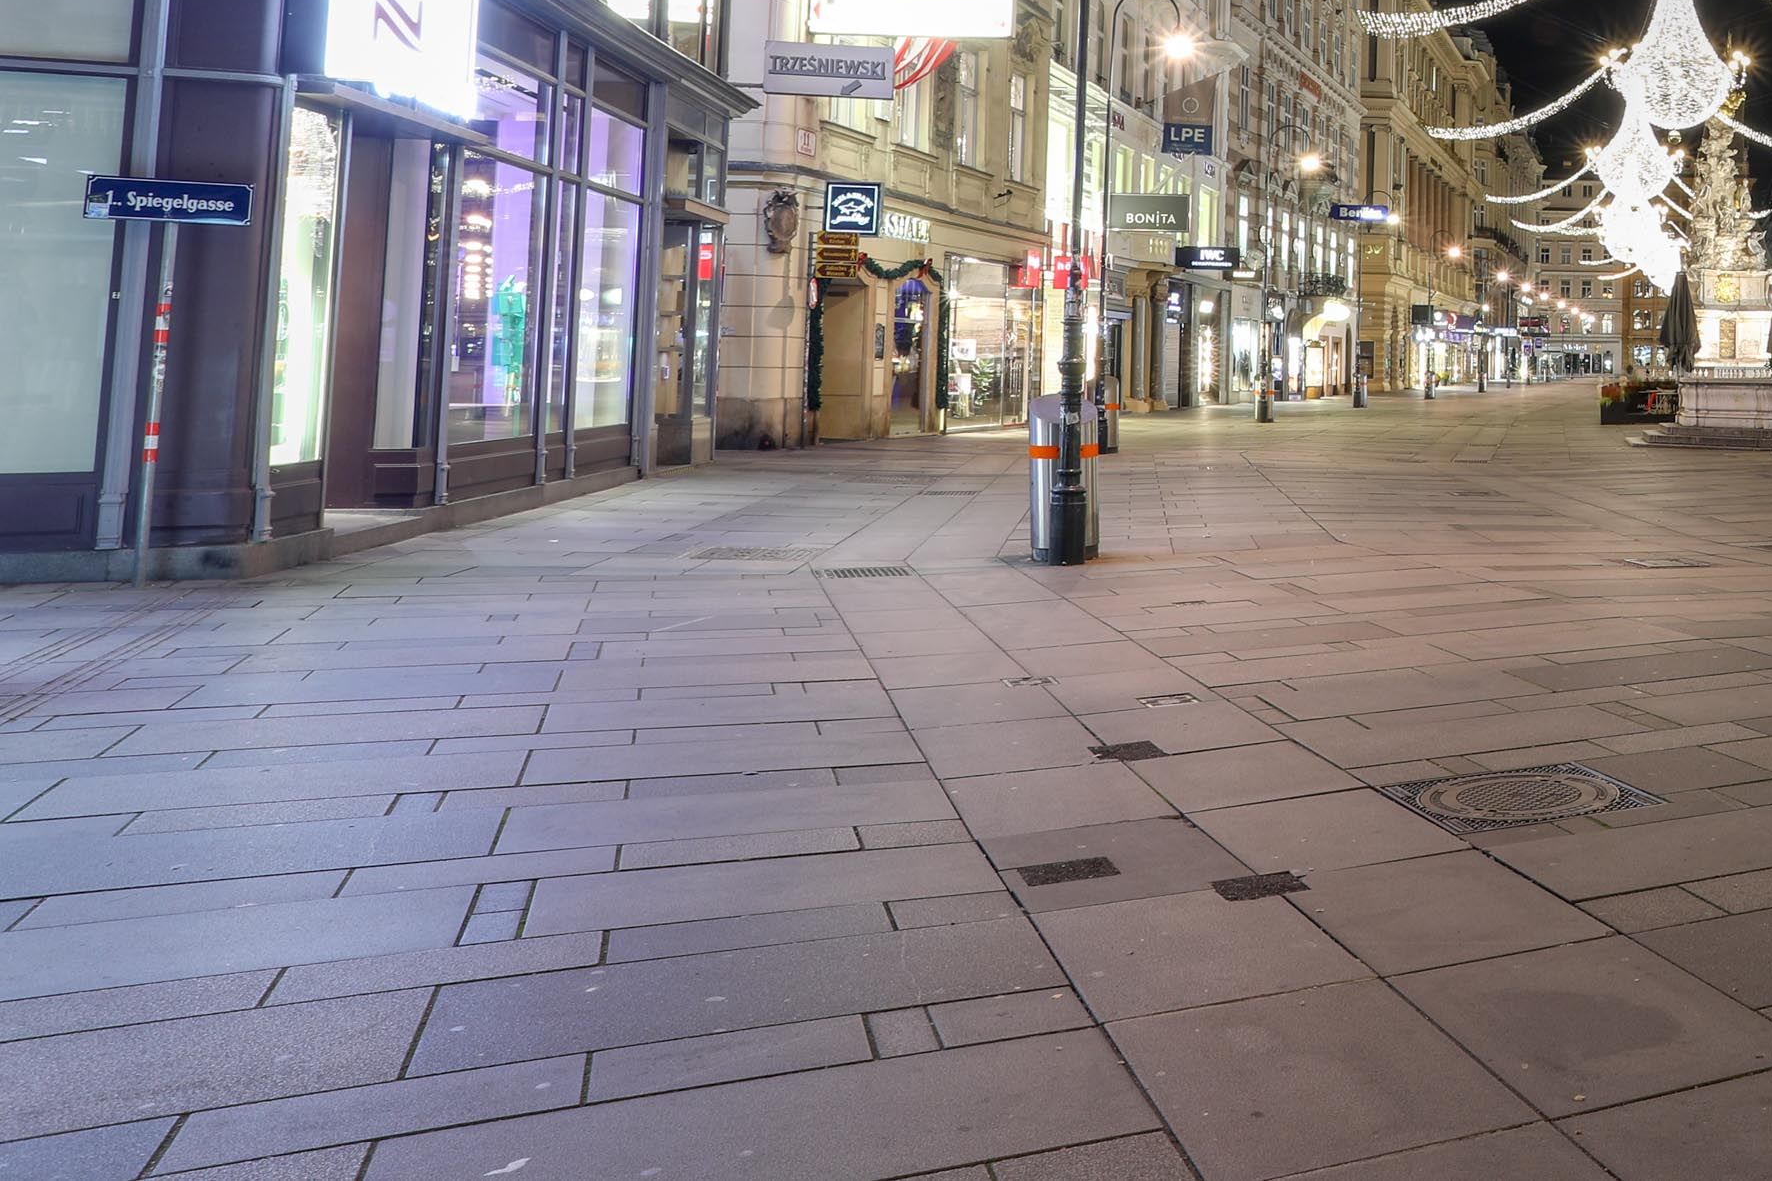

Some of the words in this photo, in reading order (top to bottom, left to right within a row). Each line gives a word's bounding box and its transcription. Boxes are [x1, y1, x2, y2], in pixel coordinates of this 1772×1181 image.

[1170, 127, 1205, 142] LPE
[127, 191, 234, 213] Spiegelgasse
[1126, 211, 1176, 227] BONITA
[1200, 249, 1225, 261] IWC
